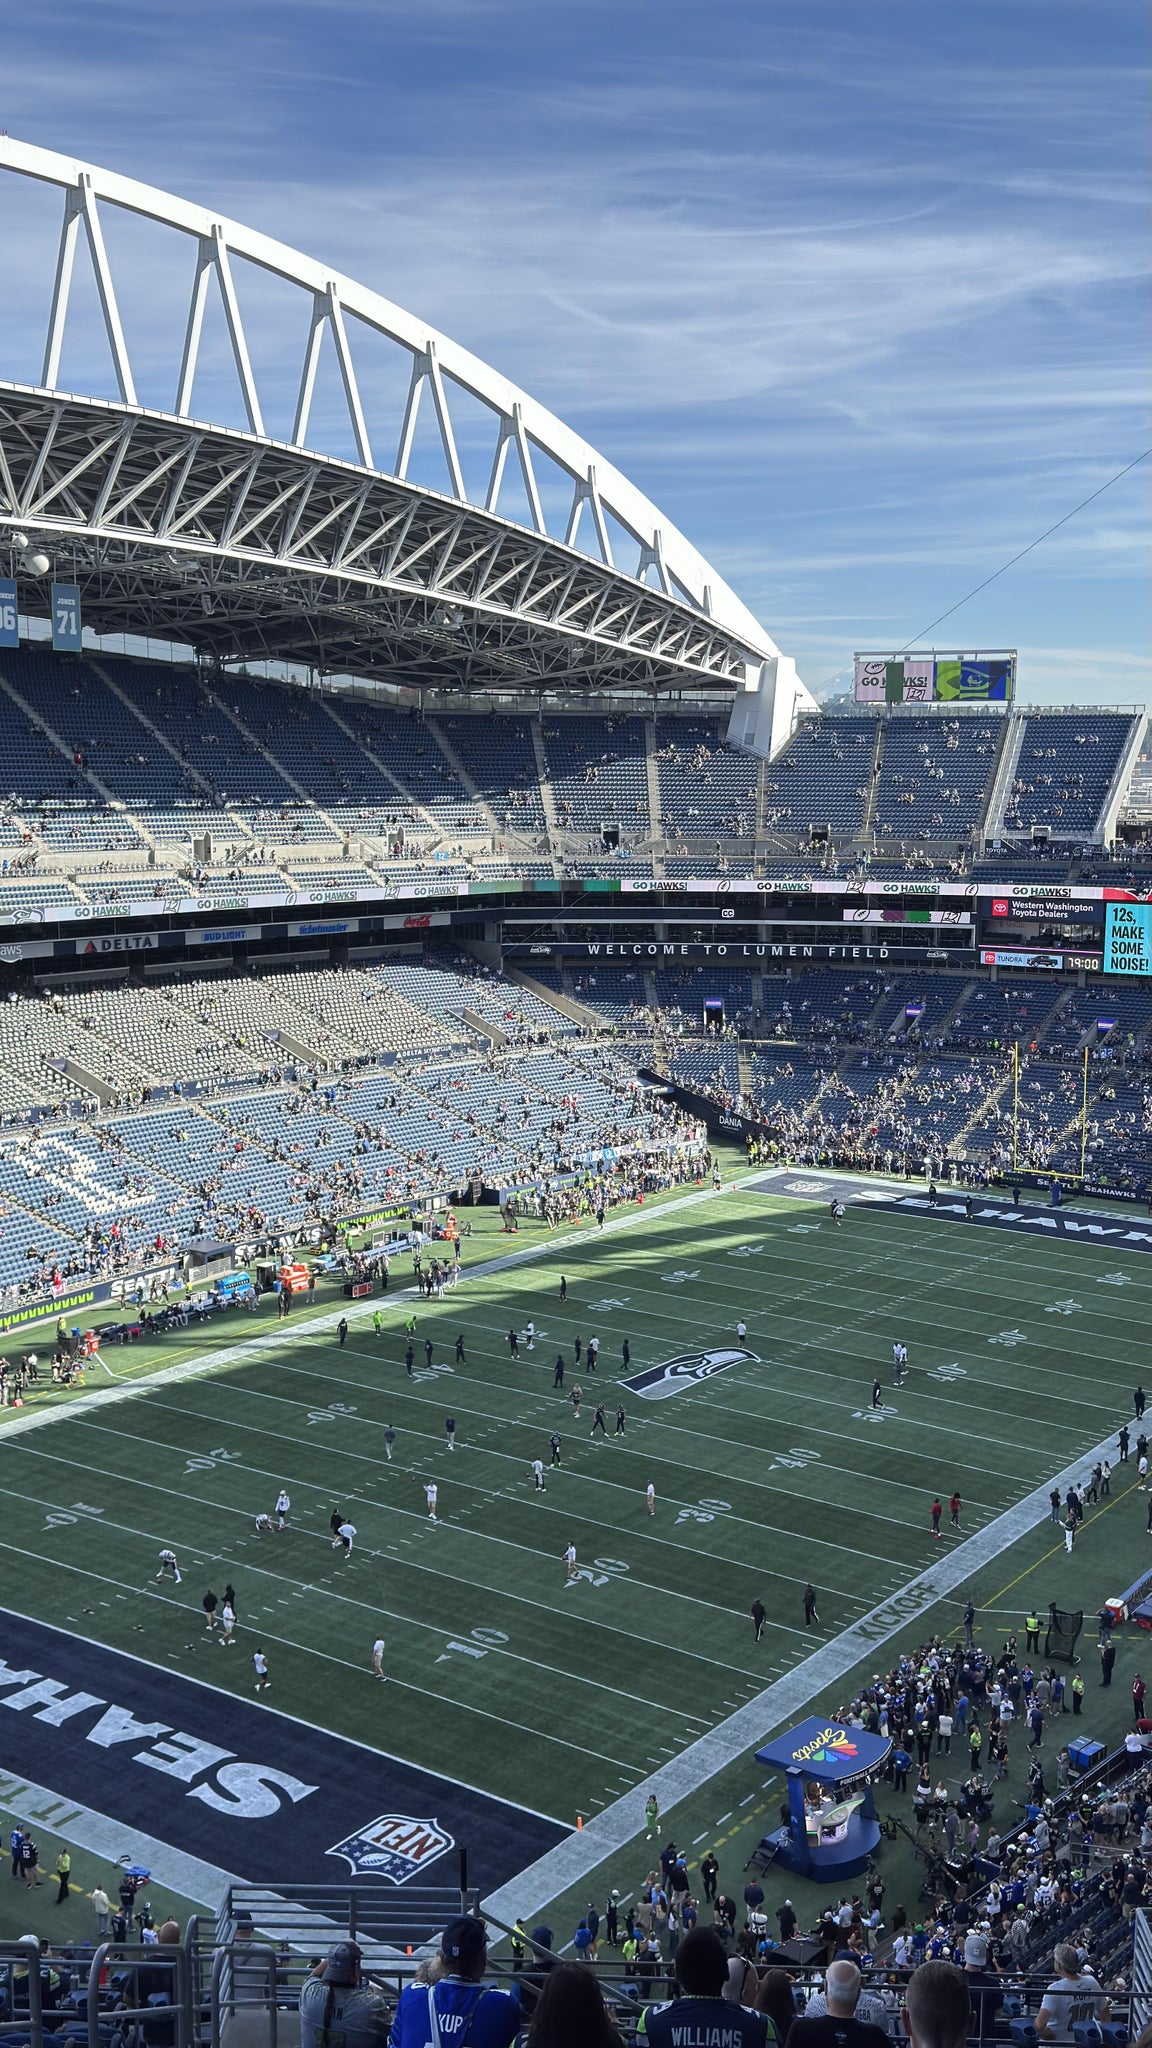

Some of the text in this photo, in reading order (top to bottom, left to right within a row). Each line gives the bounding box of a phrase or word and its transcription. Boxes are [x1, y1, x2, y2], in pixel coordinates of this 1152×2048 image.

[0, 605, 15, 630] 6
[56, 610, 77, 635] 71
[862, 677, 880, 686] GO
[414, 885, 459, 896] GO HAWKS!
[632, 881, 688, 891] GO HAWKS!
[757, 882, 813, 892] GO HAWKS!
[883, 884, 940, 894] GO HAWKS!
[1012, 887, 1072, 898] GO HAWKS!
[197, 897, 249, 909] GO HAWKS!
[309, 890, 358, 902] GO HAWKS!
[75, 905, 131, 917] GO HAWKS!
[1012, 900, 1094, 913] Western Washington
[1012, 909, 1069, 918] Toyota Dealers
[1112, 907, 1136, 924] 12s,
[204, 930, 246, 941] BUD LIGHT
[299, 923, 348, 934] ticketmaster
[1111, 925, 1145, 940] MAKE
[102, 936, 152, 951] DELTA
[1111, 941, 1144, 955] SOME
[588, 945, 889, 958] WELCOME TO LUMEN FIELD
[997, 955, 1023, 964] TUNDRA
[1110, 956, 1149, 971] NOISE!
[203, 1078, 225, 1087] DELTA
[719, 1115, 742, 1128] DANIA
[1084, 1184, 1136, 1198] SEAHAWKS
[927, 1365, 968, 1382] 40
[307, 1403, 357, 1421] 30
[186, 1447, 241, 1470] 20
[774, 1448, 821, 1468] 40
[46, 1502, 104, 1525] 10
[678, 1499, 733, 1522] 30
[570, 1558, 630, 1587] 20
[851, 1581, 939, 1642] KICKOFF
[447, 1628, 509, 1659] 10
[792, 1727, 846, 1761] Sports
[28, 1801, 84, 1828] IT
[371, 1820, 443, 1861] NFL
[22, 1849, 31, 1859] 12
[671, 2027, 743, 2048] WILLIAMS
